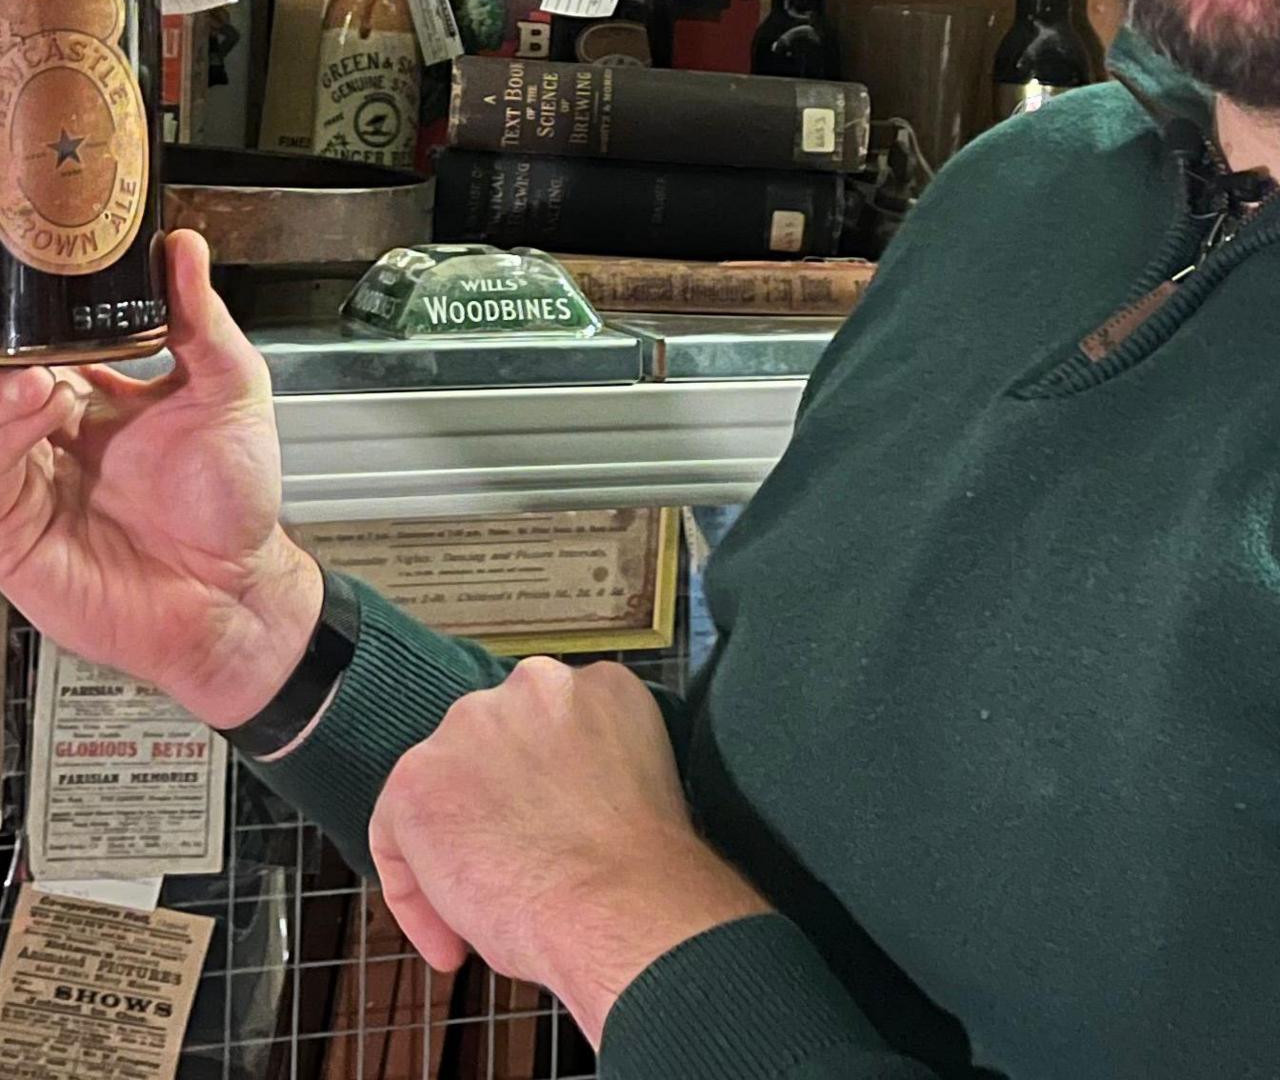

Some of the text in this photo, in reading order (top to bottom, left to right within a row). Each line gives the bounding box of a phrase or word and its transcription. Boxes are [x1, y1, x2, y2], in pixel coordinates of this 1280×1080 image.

[322, 52, 380, 89] GREEN
[483, 94, 497, 105] A
[537, 72, 560, 138] SCIENCE
[569, 71, 593, 144] BREWING
[502, 107, 523, 147] TEXT
[108, 177, 137, 237] ALE
[423, 296, 572, 324] WOODBINES
[55, 741, 206, 758] GLORIOUS BETSY
[96, 959, 182, 986] PICTURES
[53, 985, 174, 1018] SHOWS
